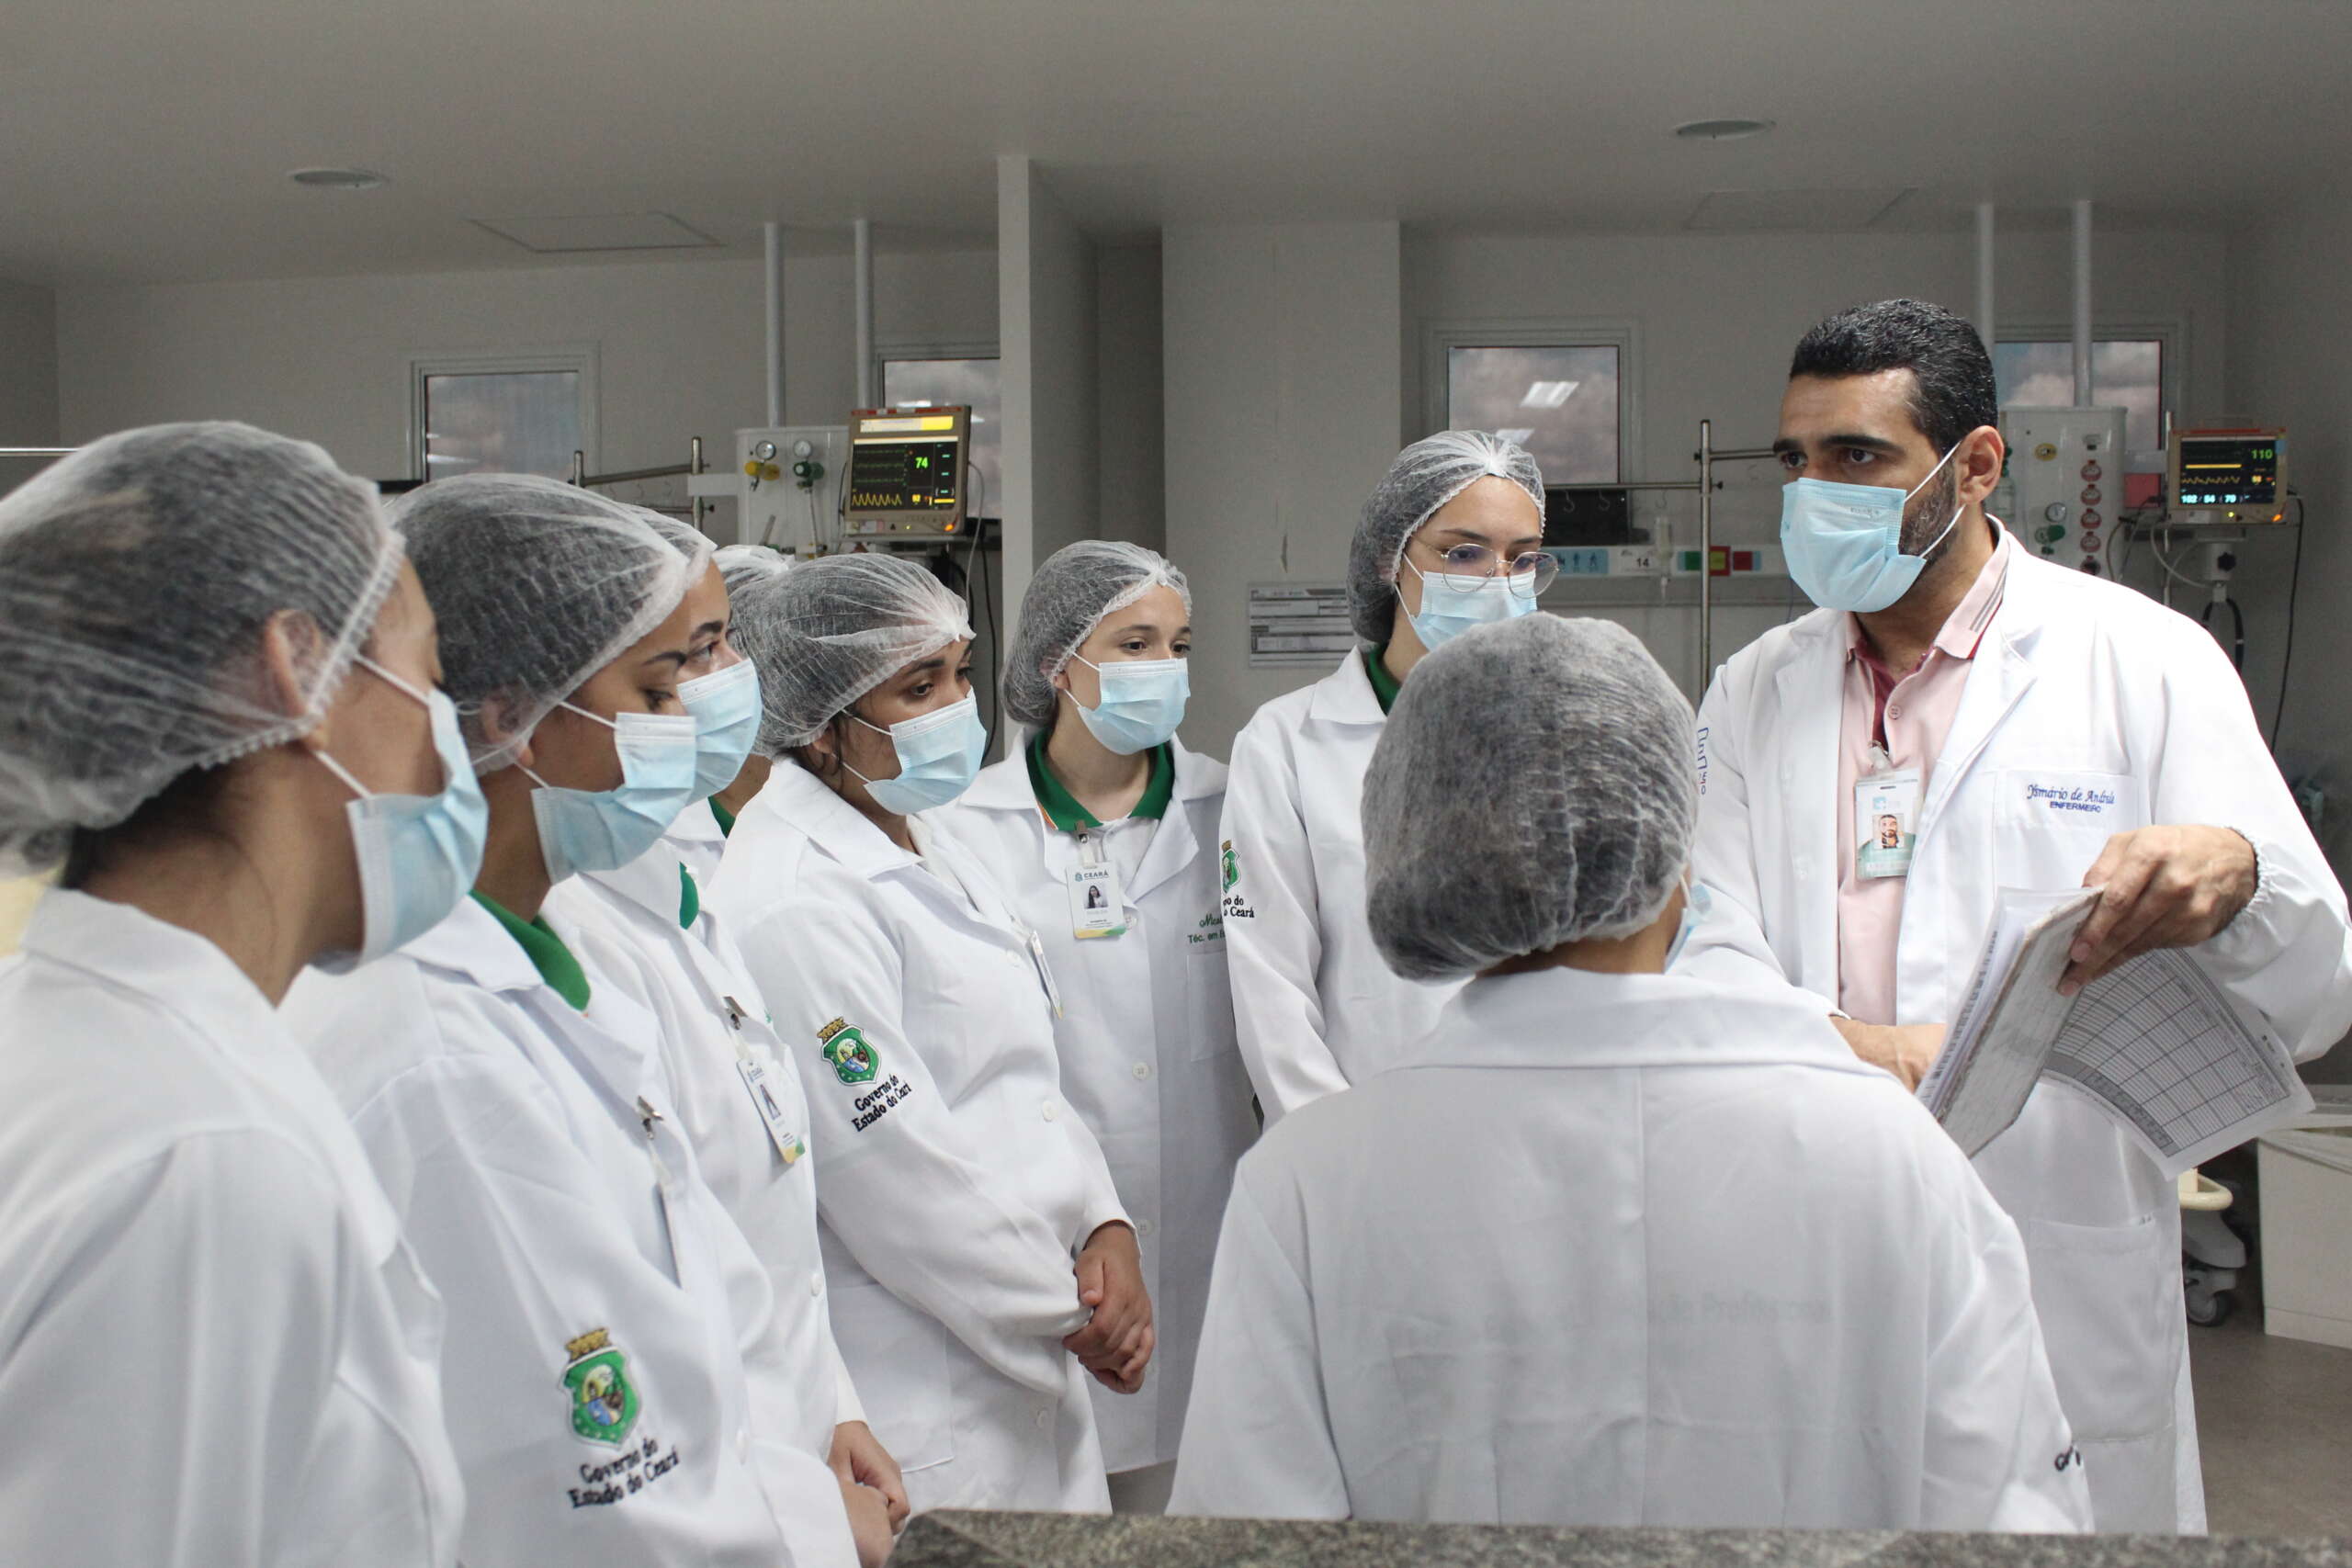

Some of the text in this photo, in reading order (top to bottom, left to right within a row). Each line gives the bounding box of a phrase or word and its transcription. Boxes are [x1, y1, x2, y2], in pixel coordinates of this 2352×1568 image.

[2251, 448, 2273, 459] 110
[915, 457, 928, 468] 74
[1636, 558, 1649, 568] 14
[2070, 786, 2083, 801] de
[1234, 895, 1244, 906] do
[1230, 906, 1255, 918] Ceará
[854, 1081, 892, 1111] Governo
[851, 1103, 887, 1132] Estado
[886, 1095, 899, 1108] do
[580, 1437, 659, 1483] Governo do
[567, 1482, 624, 1509] Estado
[627, 1472, 643, 1494] do
